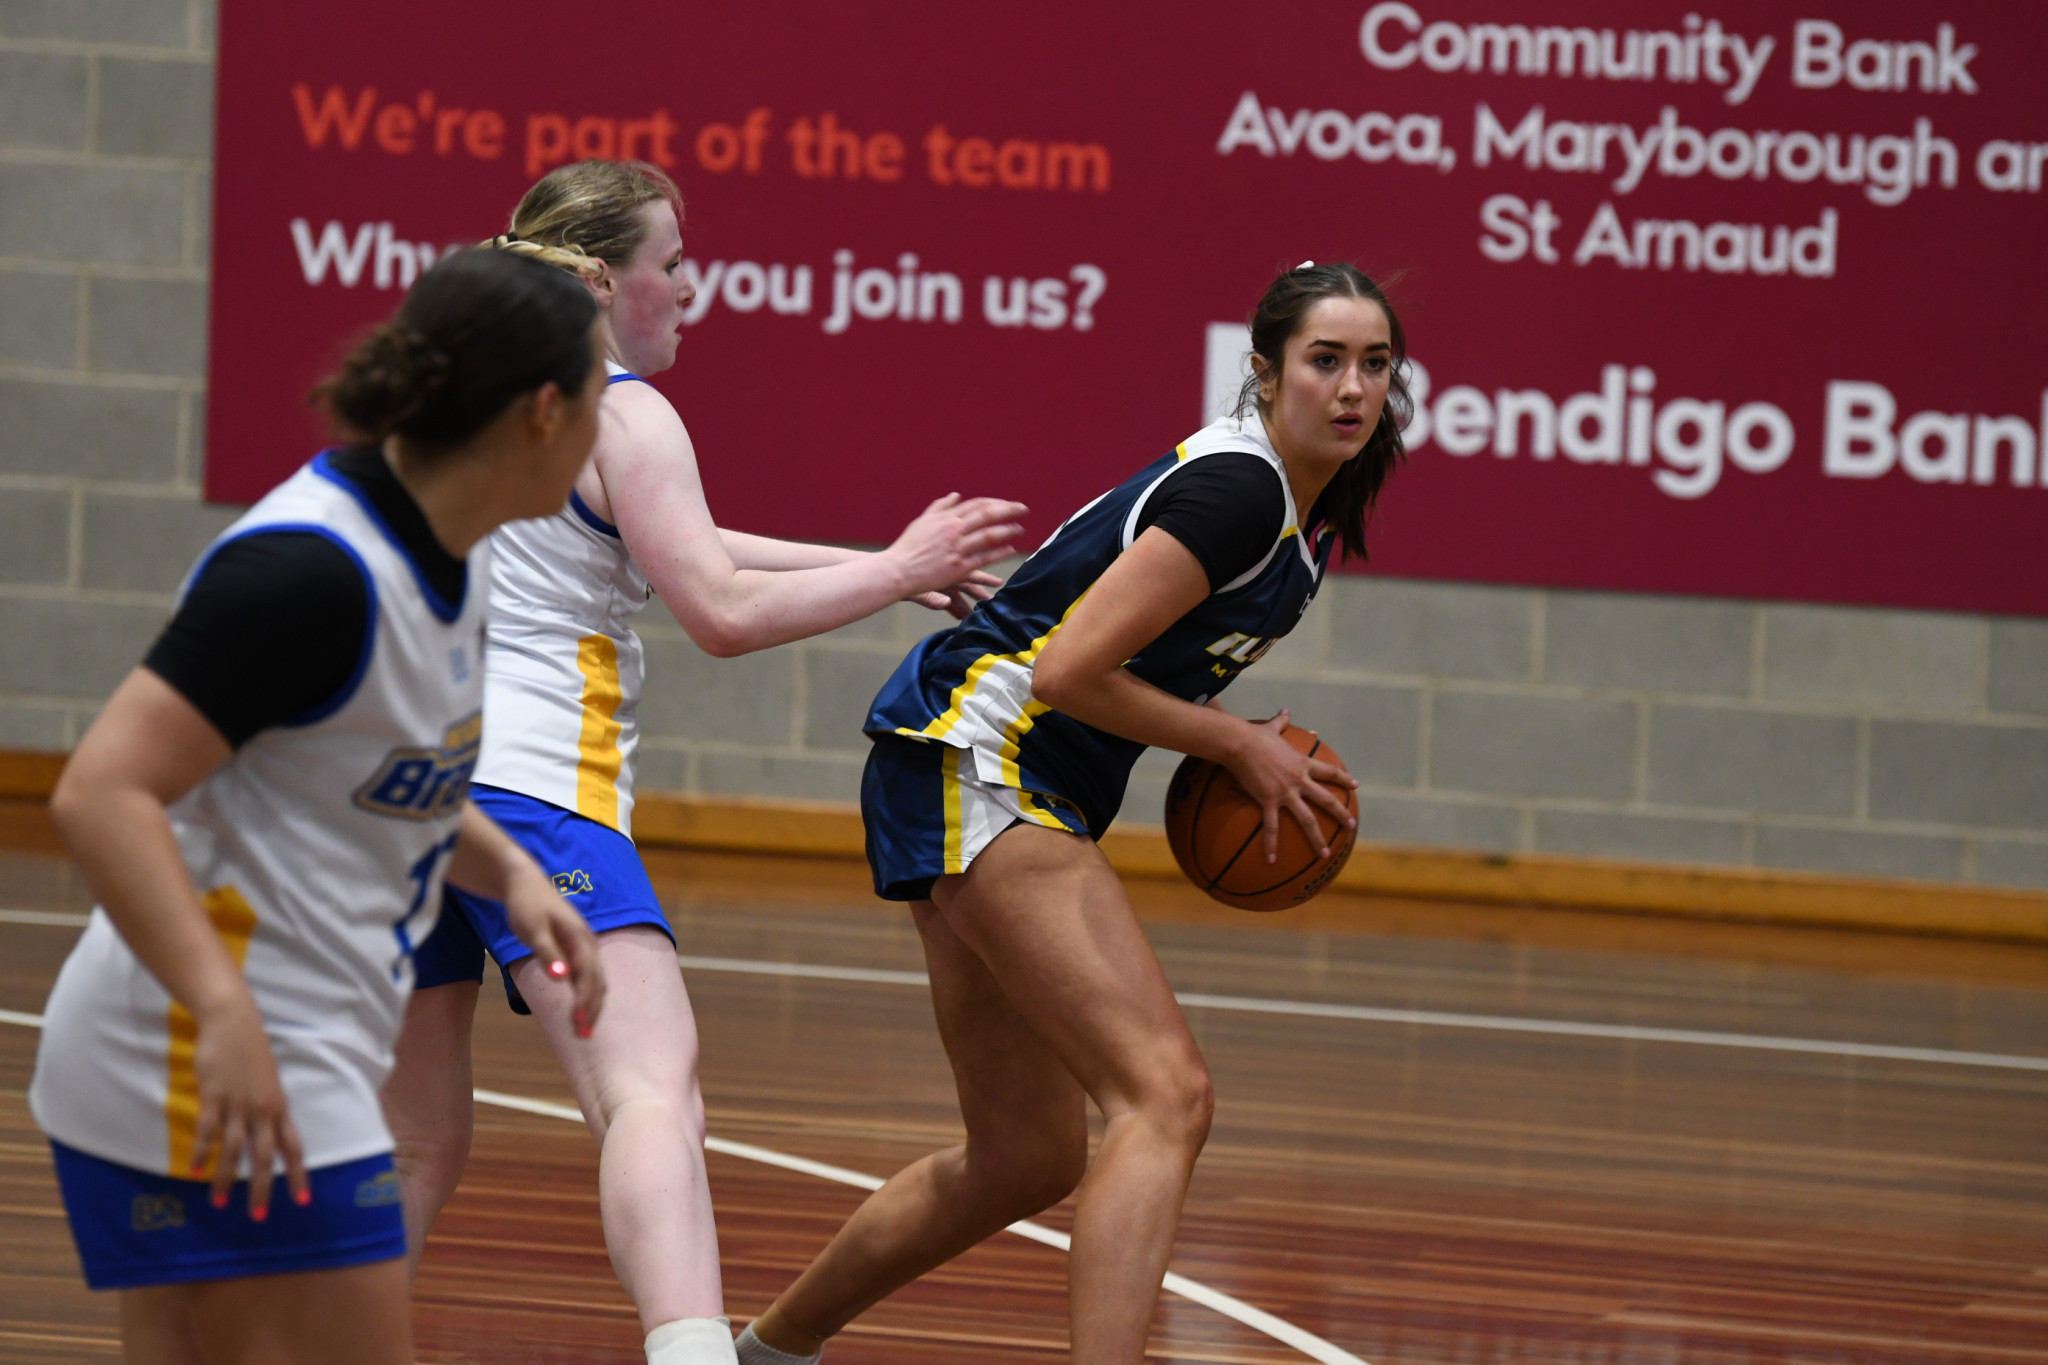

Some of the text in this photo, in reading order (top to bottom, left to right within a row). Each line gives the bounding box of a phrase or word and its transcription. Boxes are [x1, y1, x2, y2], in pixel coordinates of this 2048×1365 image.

[1359, 1, 1978, 105] Community Bank
[294, 86, 1110, 191] We're part of the team
[1217, 92, 1457, 172] Avoca,
[1472, 104, 1959, 208] Maryborough
[1479, 193, 1839, 278] St Arnaud
[682, 258, 814, 328] you
[822, 248, 964, 335] join
[982, 262, 1108, 332] us?
[1822, 379, 2048, 489] Ban
